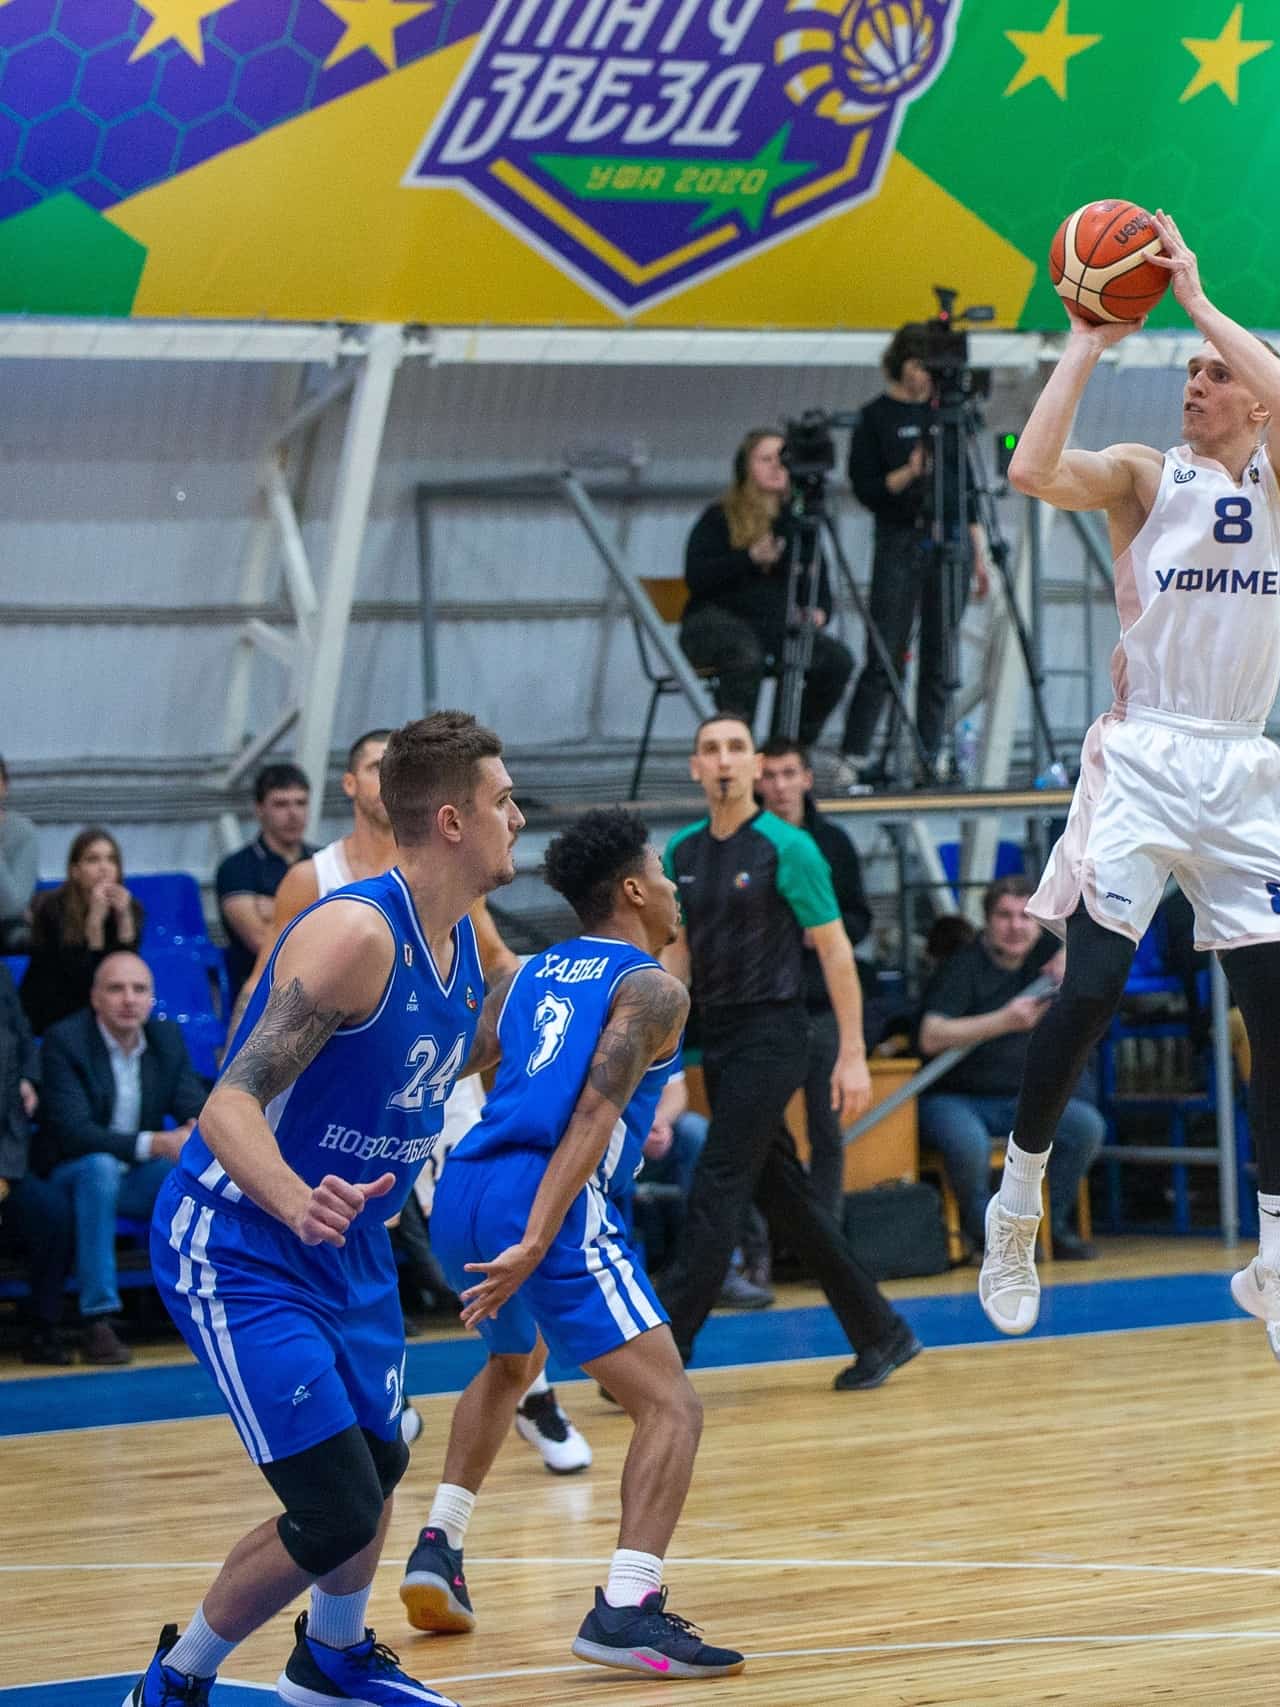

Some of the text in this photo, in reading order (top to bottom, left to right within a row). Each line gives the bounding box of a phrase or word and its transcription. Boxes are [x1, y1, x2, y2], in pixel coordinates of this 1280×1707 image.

[437, 52, 766, 164] ЗВЕЗД
[586, 165, 768, 195] УФА 2020
[1213, 496, 1253, 544] 8
[534, 953, 610, 984] ХАННА
[526, 989, 575, 1078] 3
[385, 1031, 467, 1113] 24
